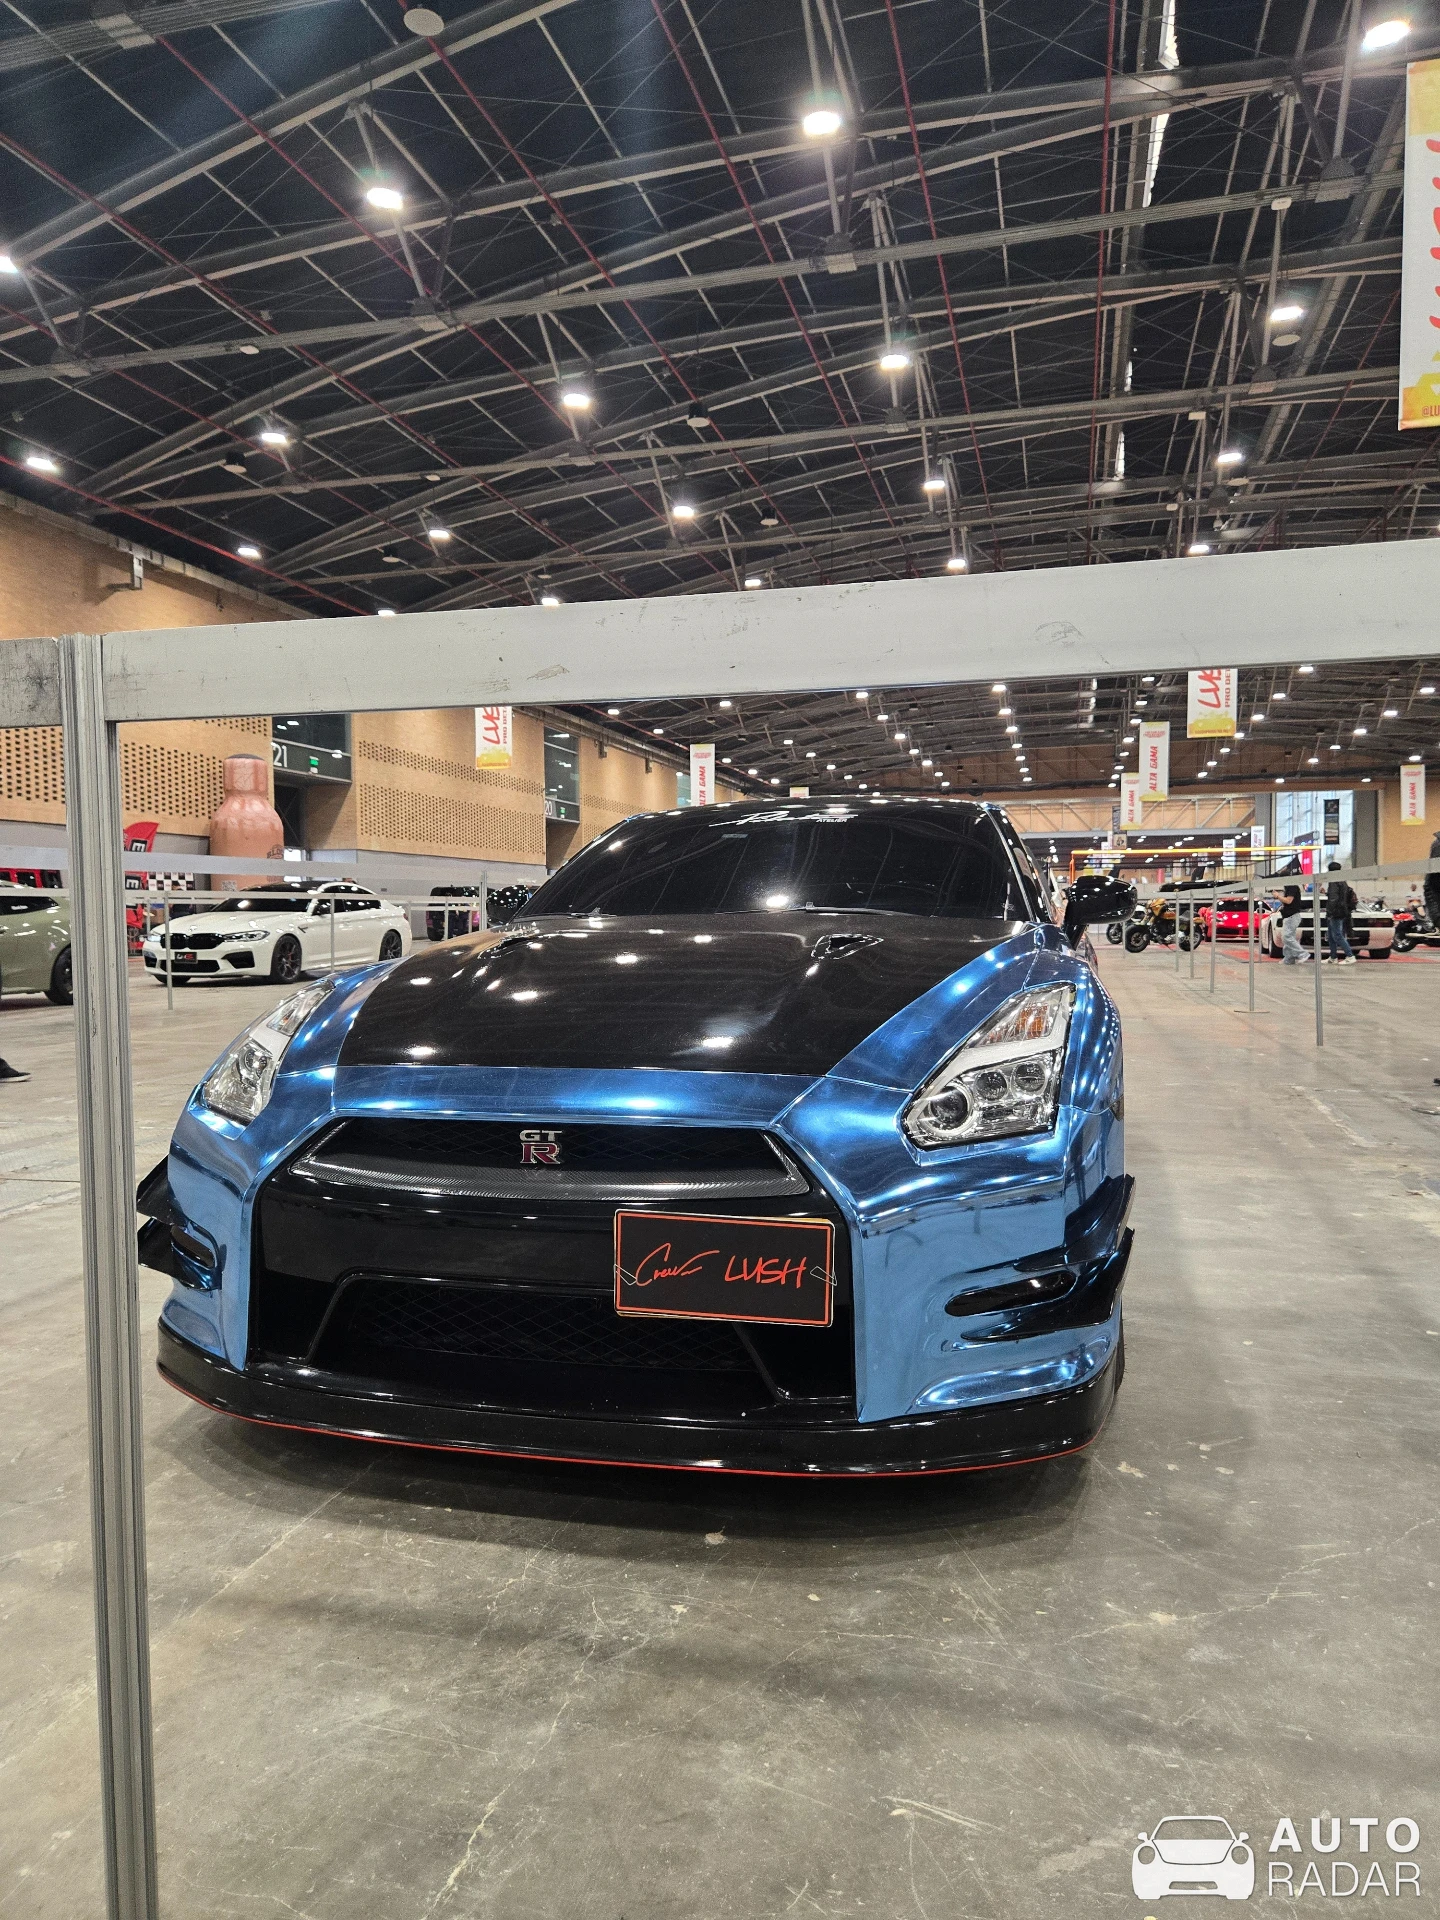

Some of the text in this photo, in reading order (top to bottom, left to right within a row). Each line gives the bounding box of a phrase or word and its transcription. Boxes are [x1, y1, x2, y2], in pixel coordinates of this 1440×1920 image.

[1421, 404, 1440, 417] @LU
[1197, 668, 1222, 708] LUS
[482, 706, 501, 744] LUS
[270, 741, 288, 768] 21
[1149, 745, 1158, 792] ALTA GAMA
[545, 800, 553, 815] 20
[519, 1129, 563, 1142] GT
[519, 1142, 561, 1165] R
[724, 1254, 807, 1289] LUSH
